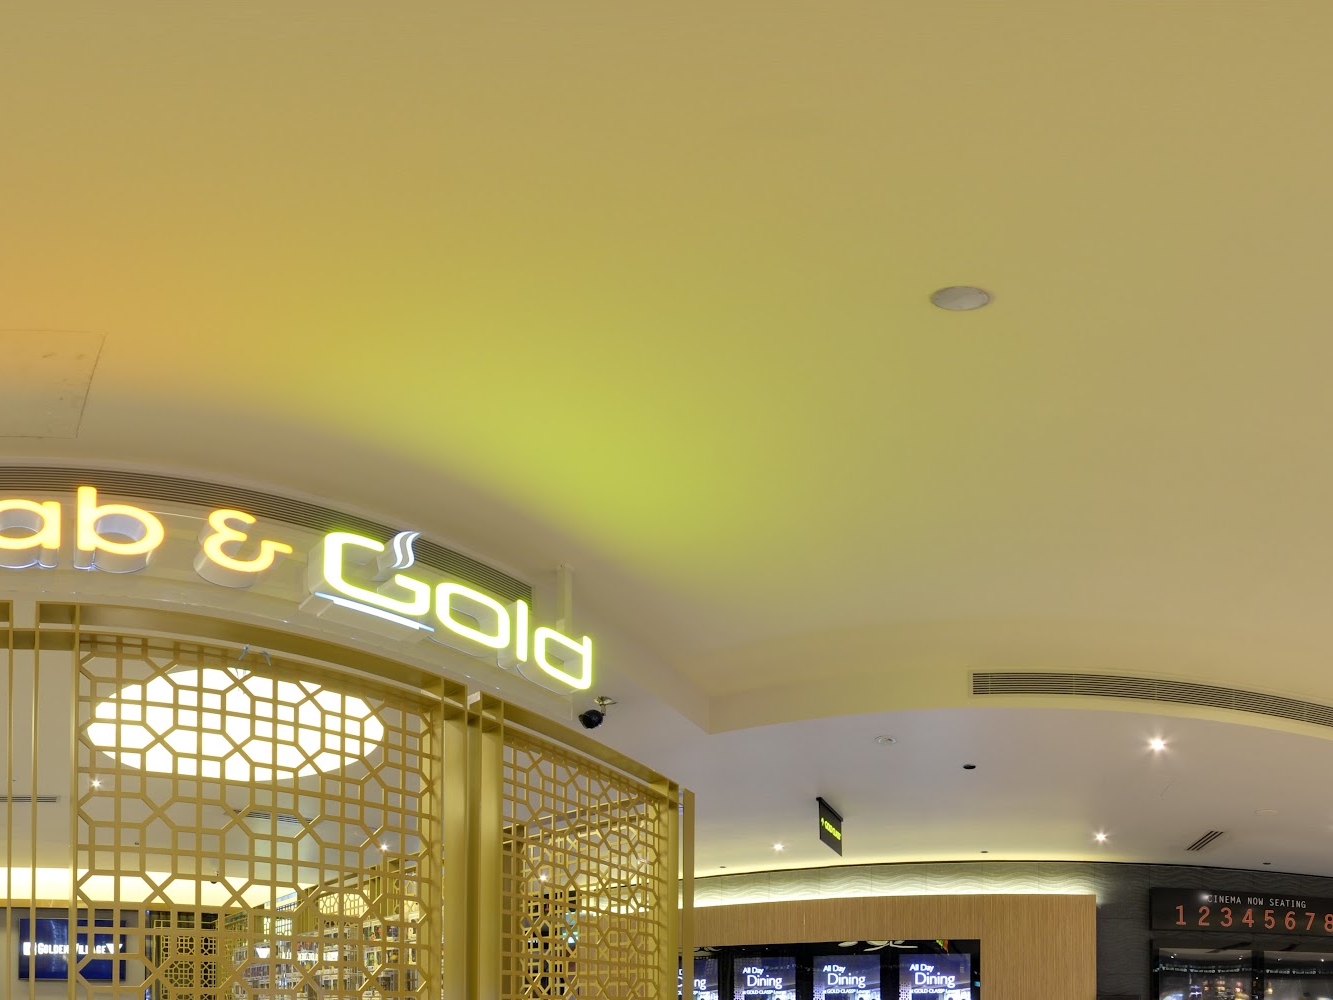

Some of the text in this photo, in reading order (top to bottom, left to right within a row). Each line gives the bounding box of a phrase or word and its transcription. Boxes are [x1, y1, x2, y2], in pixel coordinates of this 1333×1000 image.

[202, 508, 294, 574] &
[323, 530, 593, 690] Gold
[1208, 894, 1306, 908] CINEMA NOW SEATING
[1176, 905, 1186, 926] 1
[1198, 905, 1210, 926] 2
[1220, 907, 1233, 927] 3
[1242, 908, 1254, 928] 4
[1264, 910, 1275, 929] 5
[1285, 911, 1296, 930] 6
[1305, 912, 1315, 931] 7
[752, 967, 764, 975] Day
[833, 965, 846, 974] Day
[920, 964, 934, 973] Day
[747, 975, 782, 989] Dining
[828, 973, 866, 988] Dining
[915, 972, 955, 988] Dining
